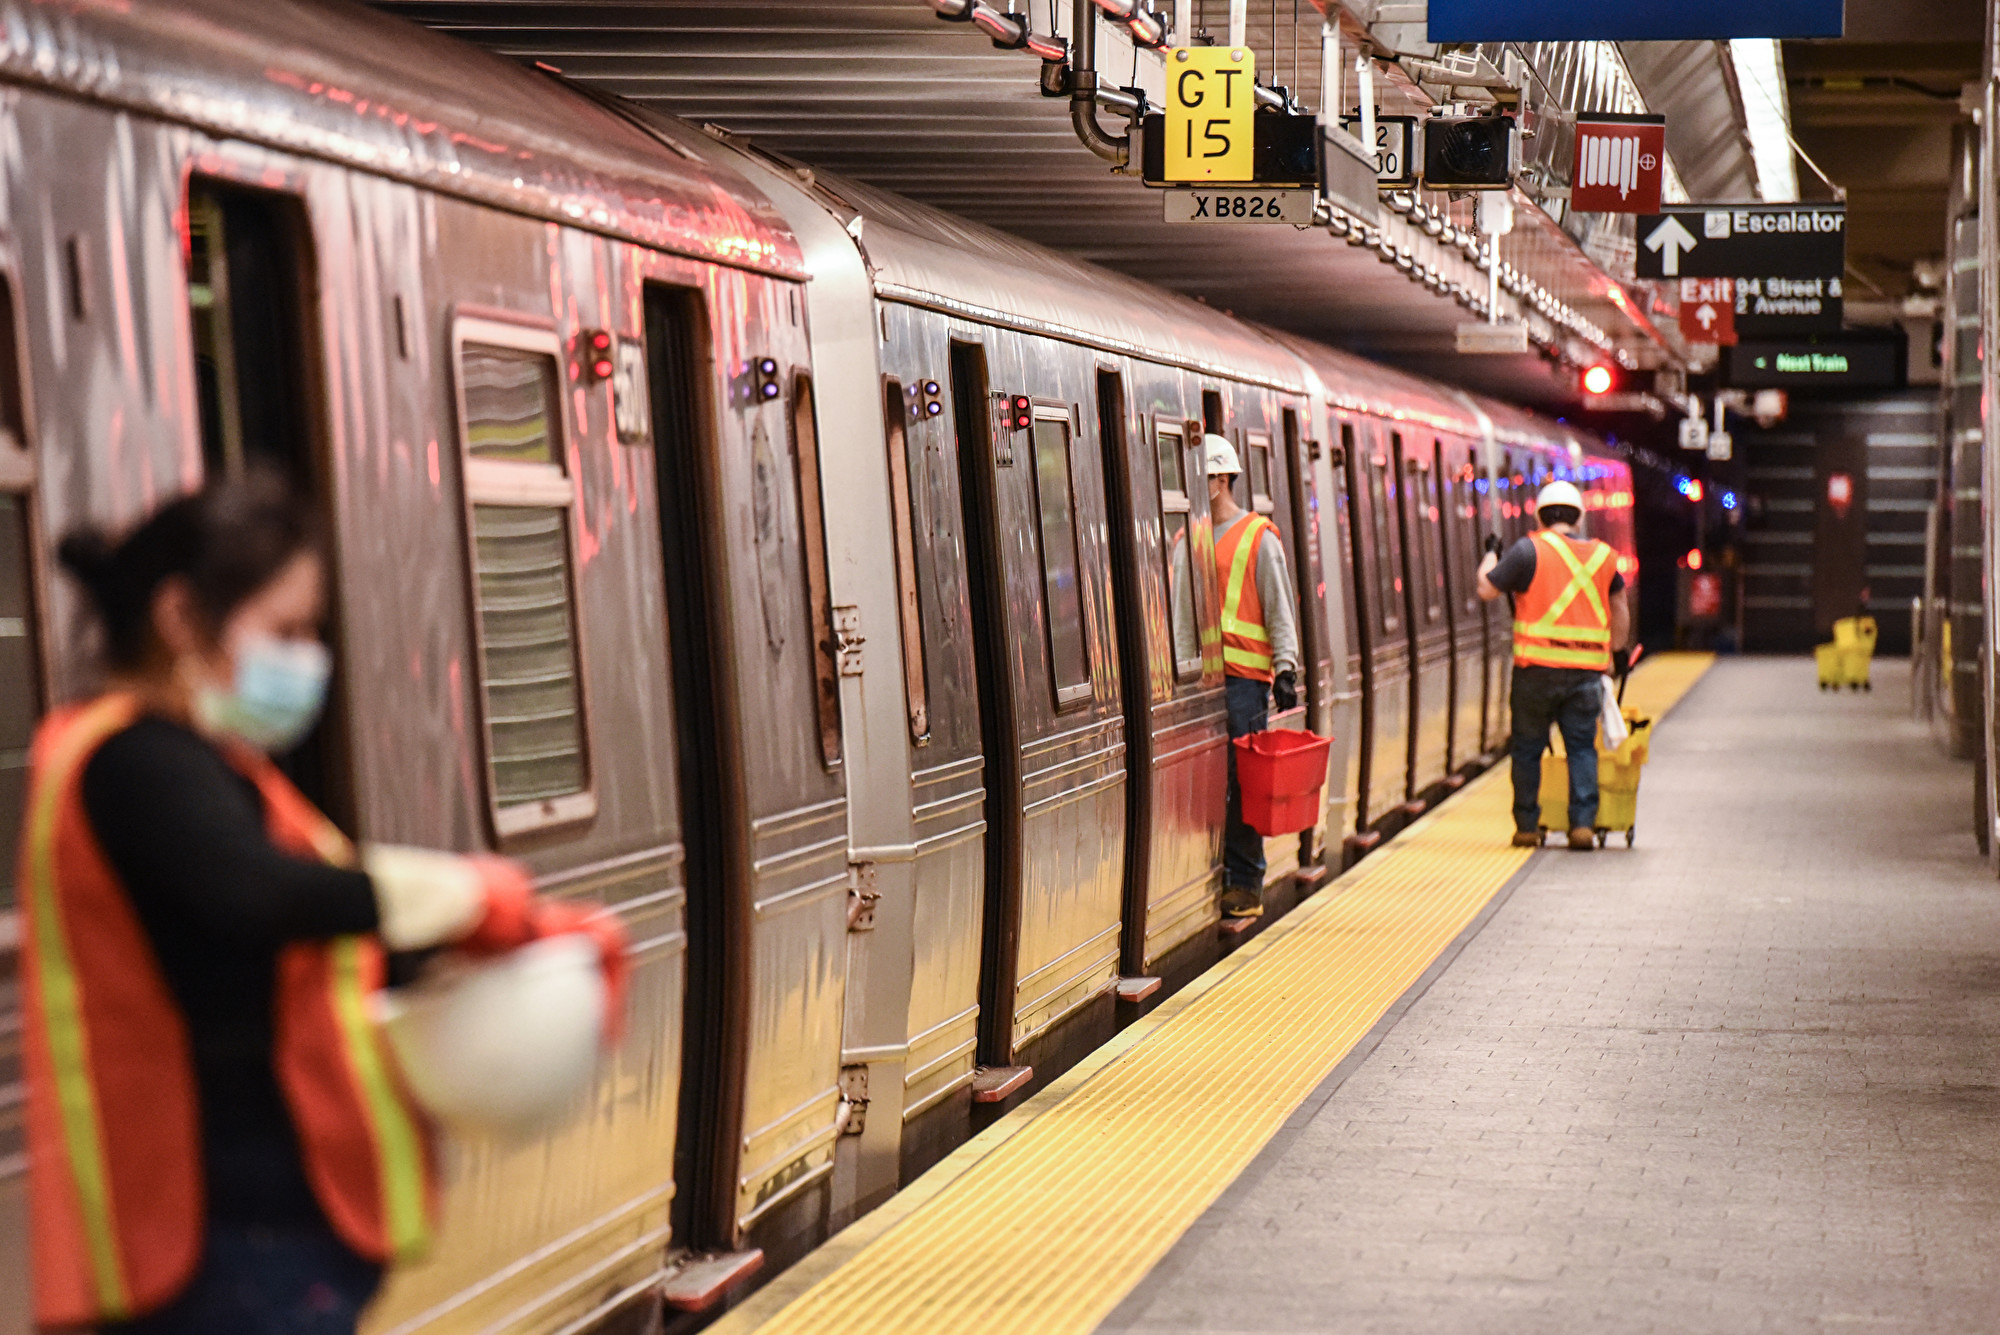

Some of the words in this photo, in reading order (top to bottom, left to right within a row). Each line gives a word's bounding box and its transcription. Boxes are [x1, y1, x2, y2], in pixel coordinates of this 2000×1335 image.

[1178, 69, 1242, 108] GT
[1186, 119, 1231, 158] 15
[1733, 210, 1845, 233] Escalator
[1680, 277, 1732, 303] Exit
[1766, 277, 1823, 298] Street
[1754, 295, 1822, 315] Avenue
